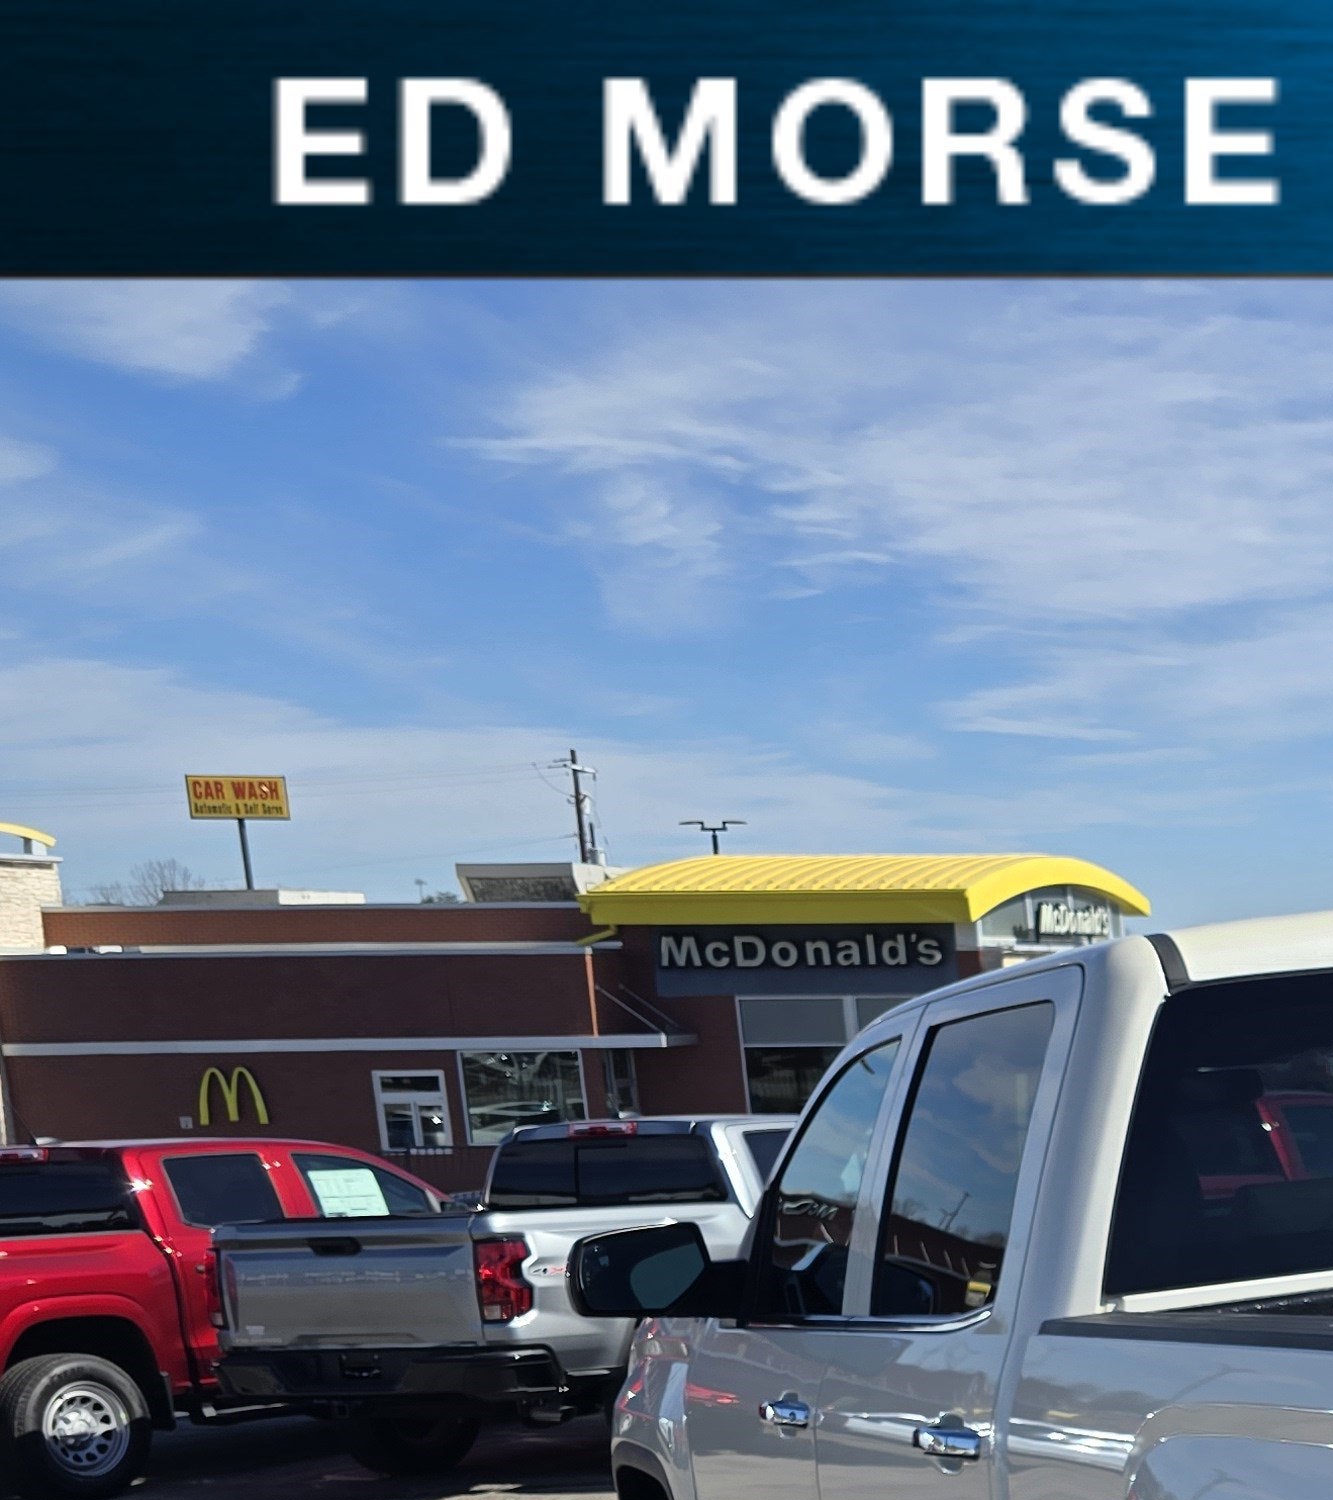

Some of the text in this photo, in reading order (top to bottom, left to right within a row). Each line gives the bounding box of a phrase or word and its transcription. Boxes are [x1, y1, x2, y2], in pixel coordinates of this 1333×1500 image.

[192, 781, 280, 800] CAR WASH
[1039, 902, 1110, 936] McDonald's
[660, 934, 942, 968] McDonald's
